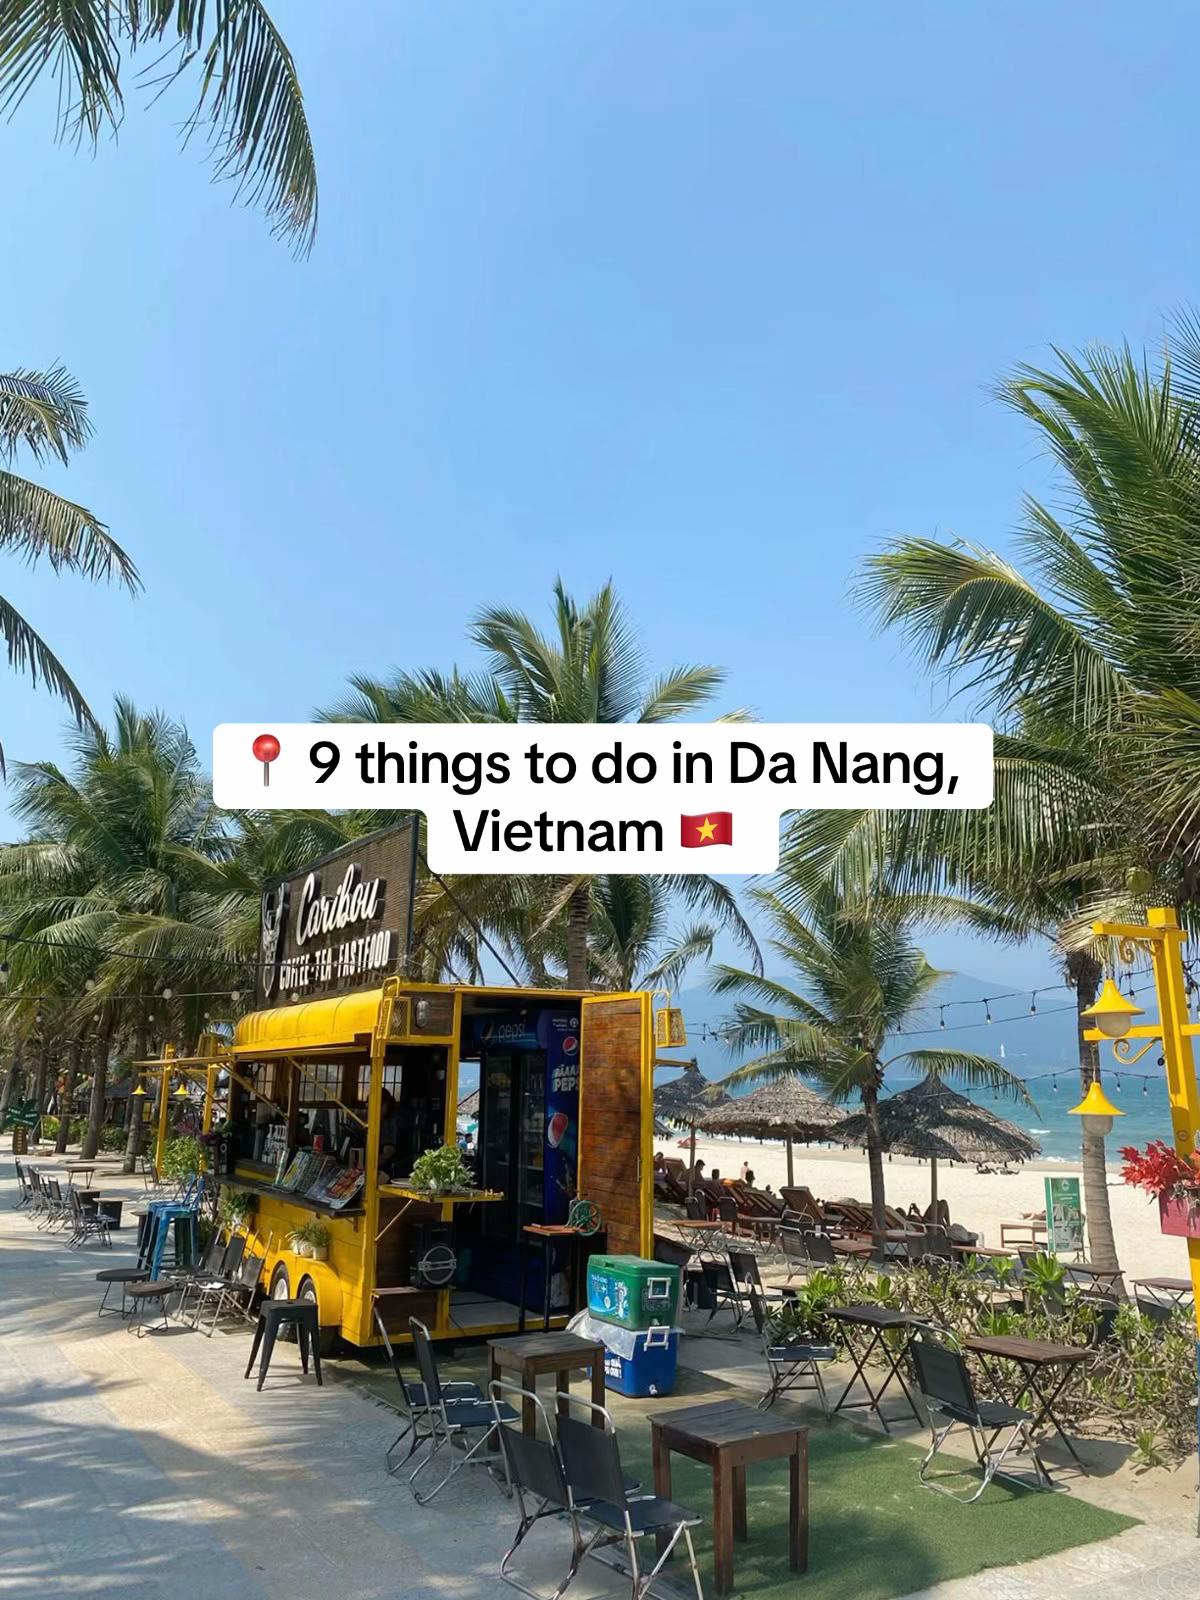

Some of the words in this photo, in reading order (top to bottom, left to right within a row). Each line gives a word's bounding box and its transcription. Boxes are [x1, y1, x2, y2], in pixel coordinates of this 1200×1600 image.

[296, 863, 381, 946] Caribou
[280, 954, 310, 990] COFFEE
[315, 947, 332, 981] TEA
[498, 1022, 525, 1041] pepsi
